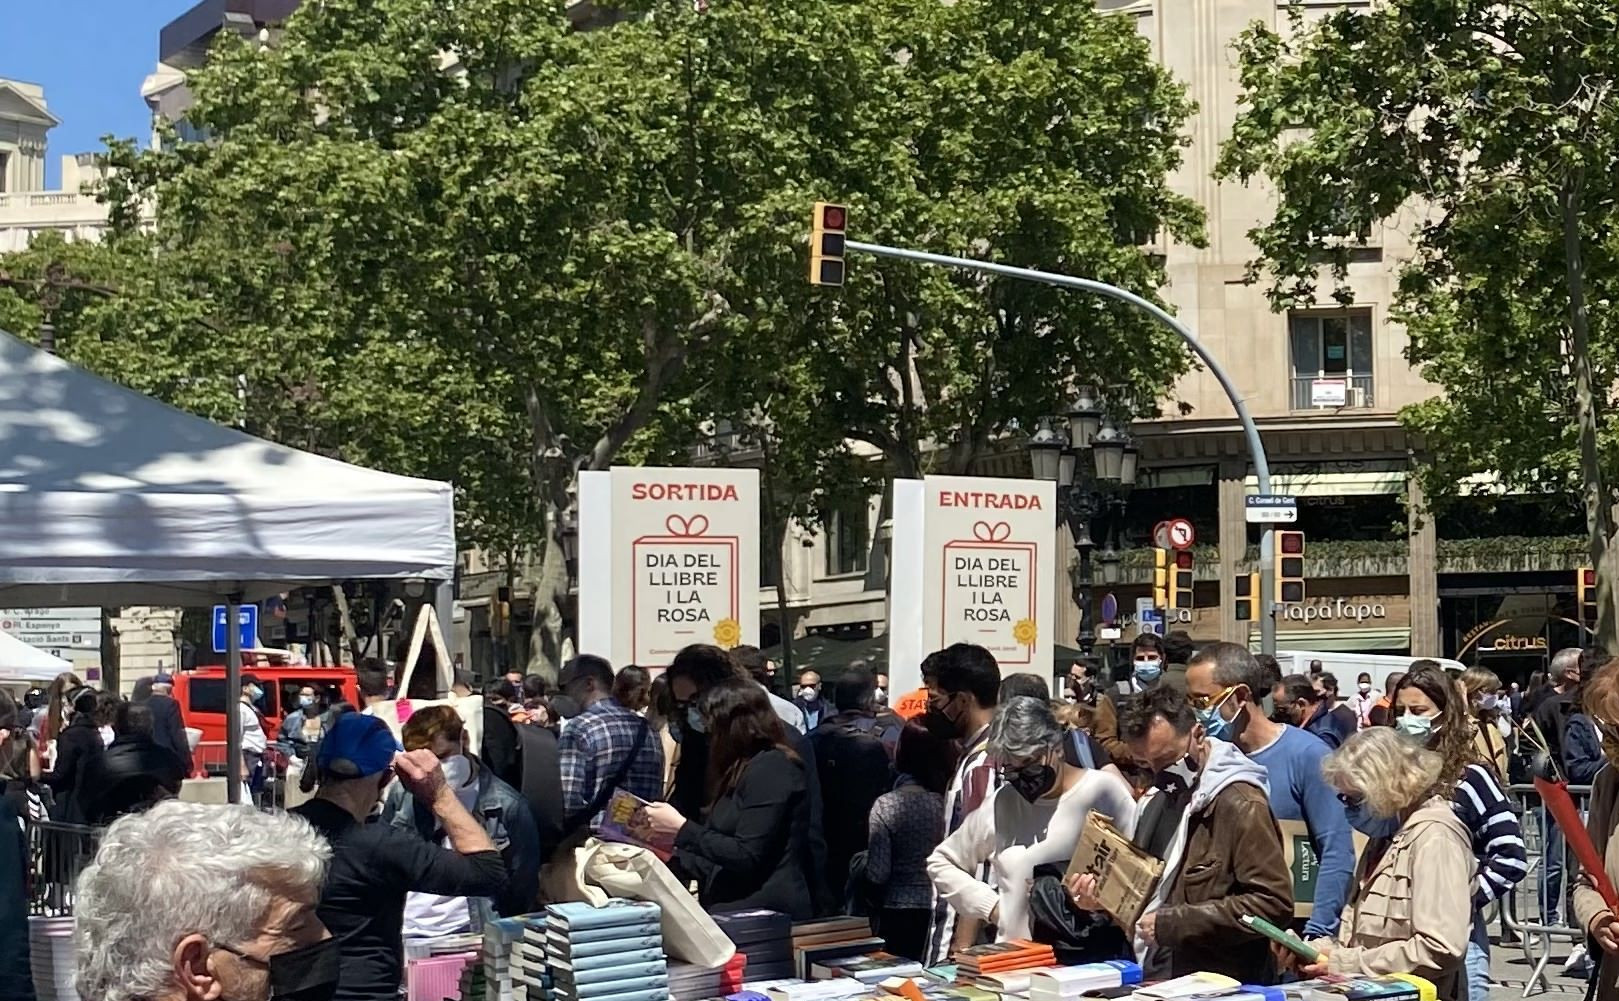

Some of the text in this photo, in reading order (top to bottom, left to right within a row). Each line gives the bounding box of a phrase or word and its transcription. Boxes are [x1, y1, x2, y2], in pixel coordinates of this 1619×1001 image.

[632, 483, 739, 501] SORTIDA
[939, 491, 1042, 510] ENTRADA
[646, 554, 720, 568] DIA DEL
[955, 557, 1021, 571] DIA DEL
[649, 572, 717, 586] LLIBRE
[957, 575, 1018, 588] LLIBRE
[667, 590, 701, 603] I LA
[972, 592, 1003, 605] I LA
[657, 609, 710, 622] ROSA
[964, 609, 1011, 622] ROSA
[1494, 634, 1547, 650] citrus
